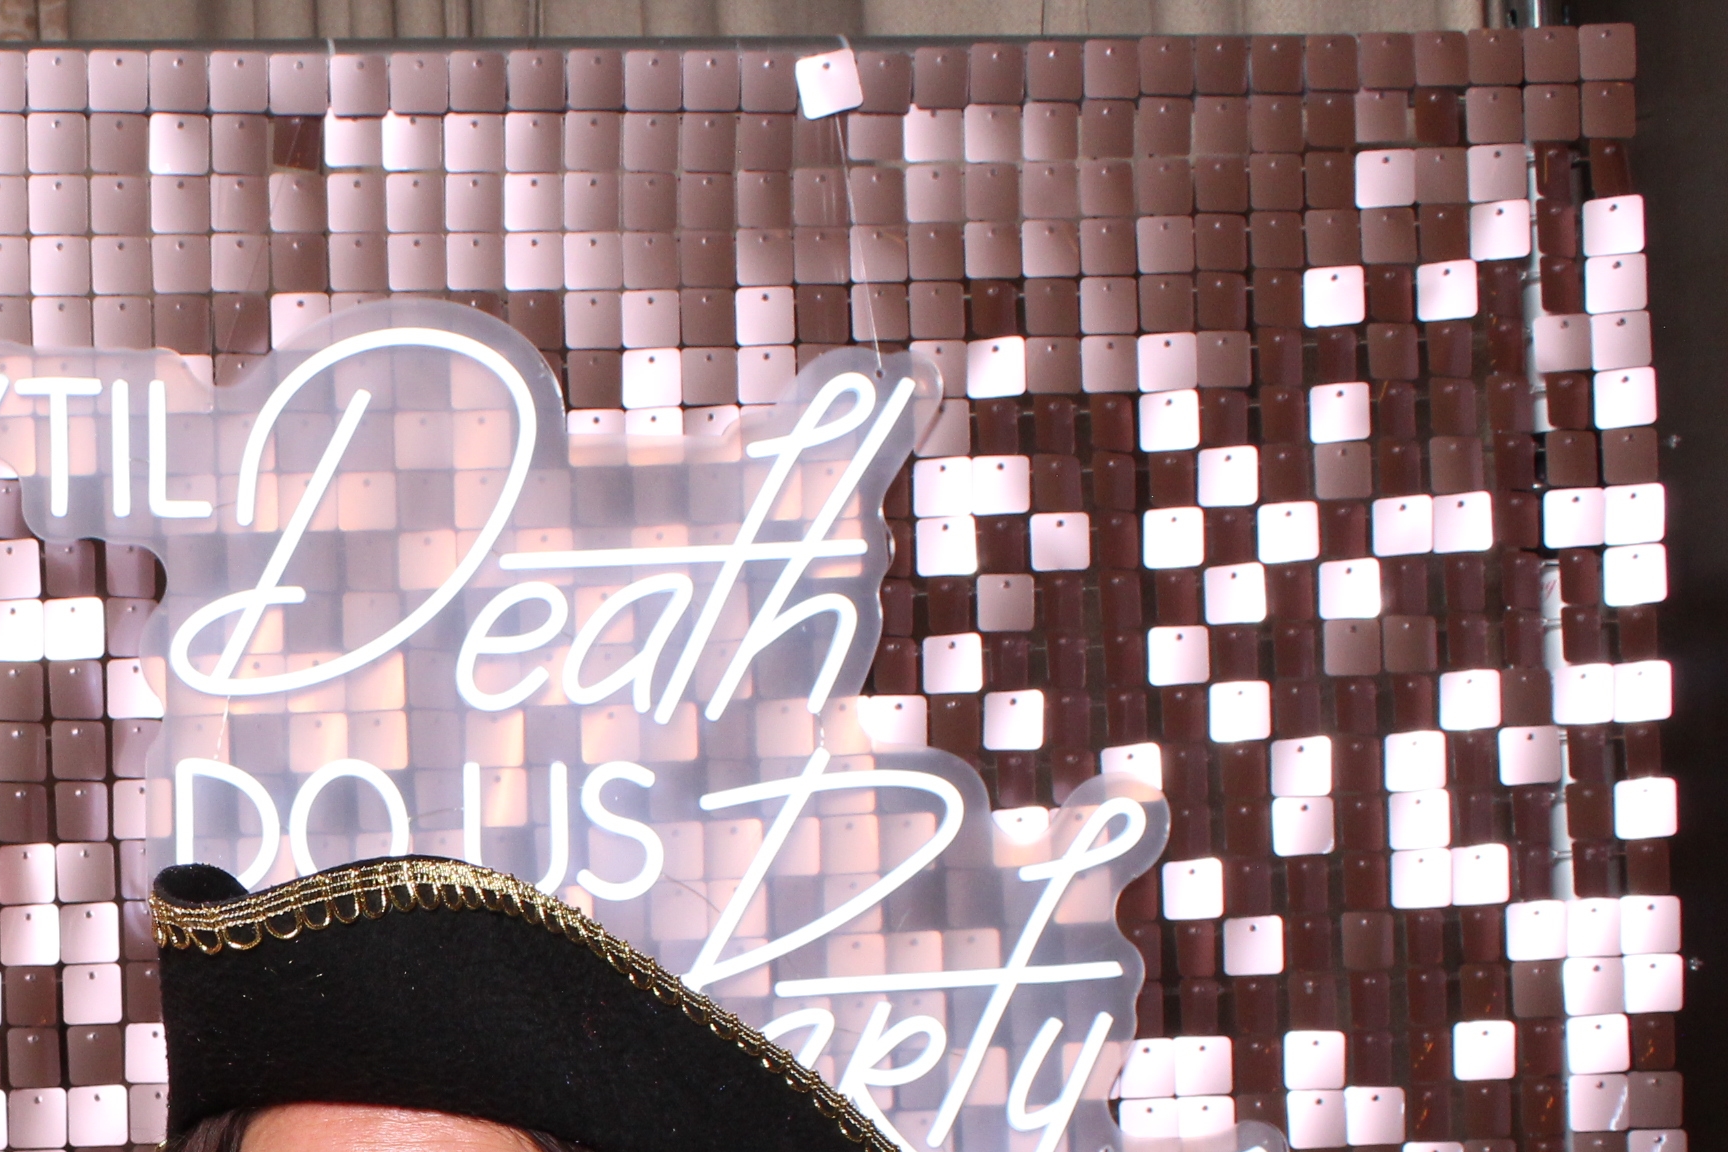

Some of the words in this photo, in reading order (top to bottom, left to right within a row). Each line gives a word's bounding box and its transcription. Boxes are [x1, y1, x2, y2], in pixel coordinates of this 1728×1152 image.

[172, 327, 914, 724] Death
[175, 758, 410, 894] DO
[463, 761, 665, 900] US
